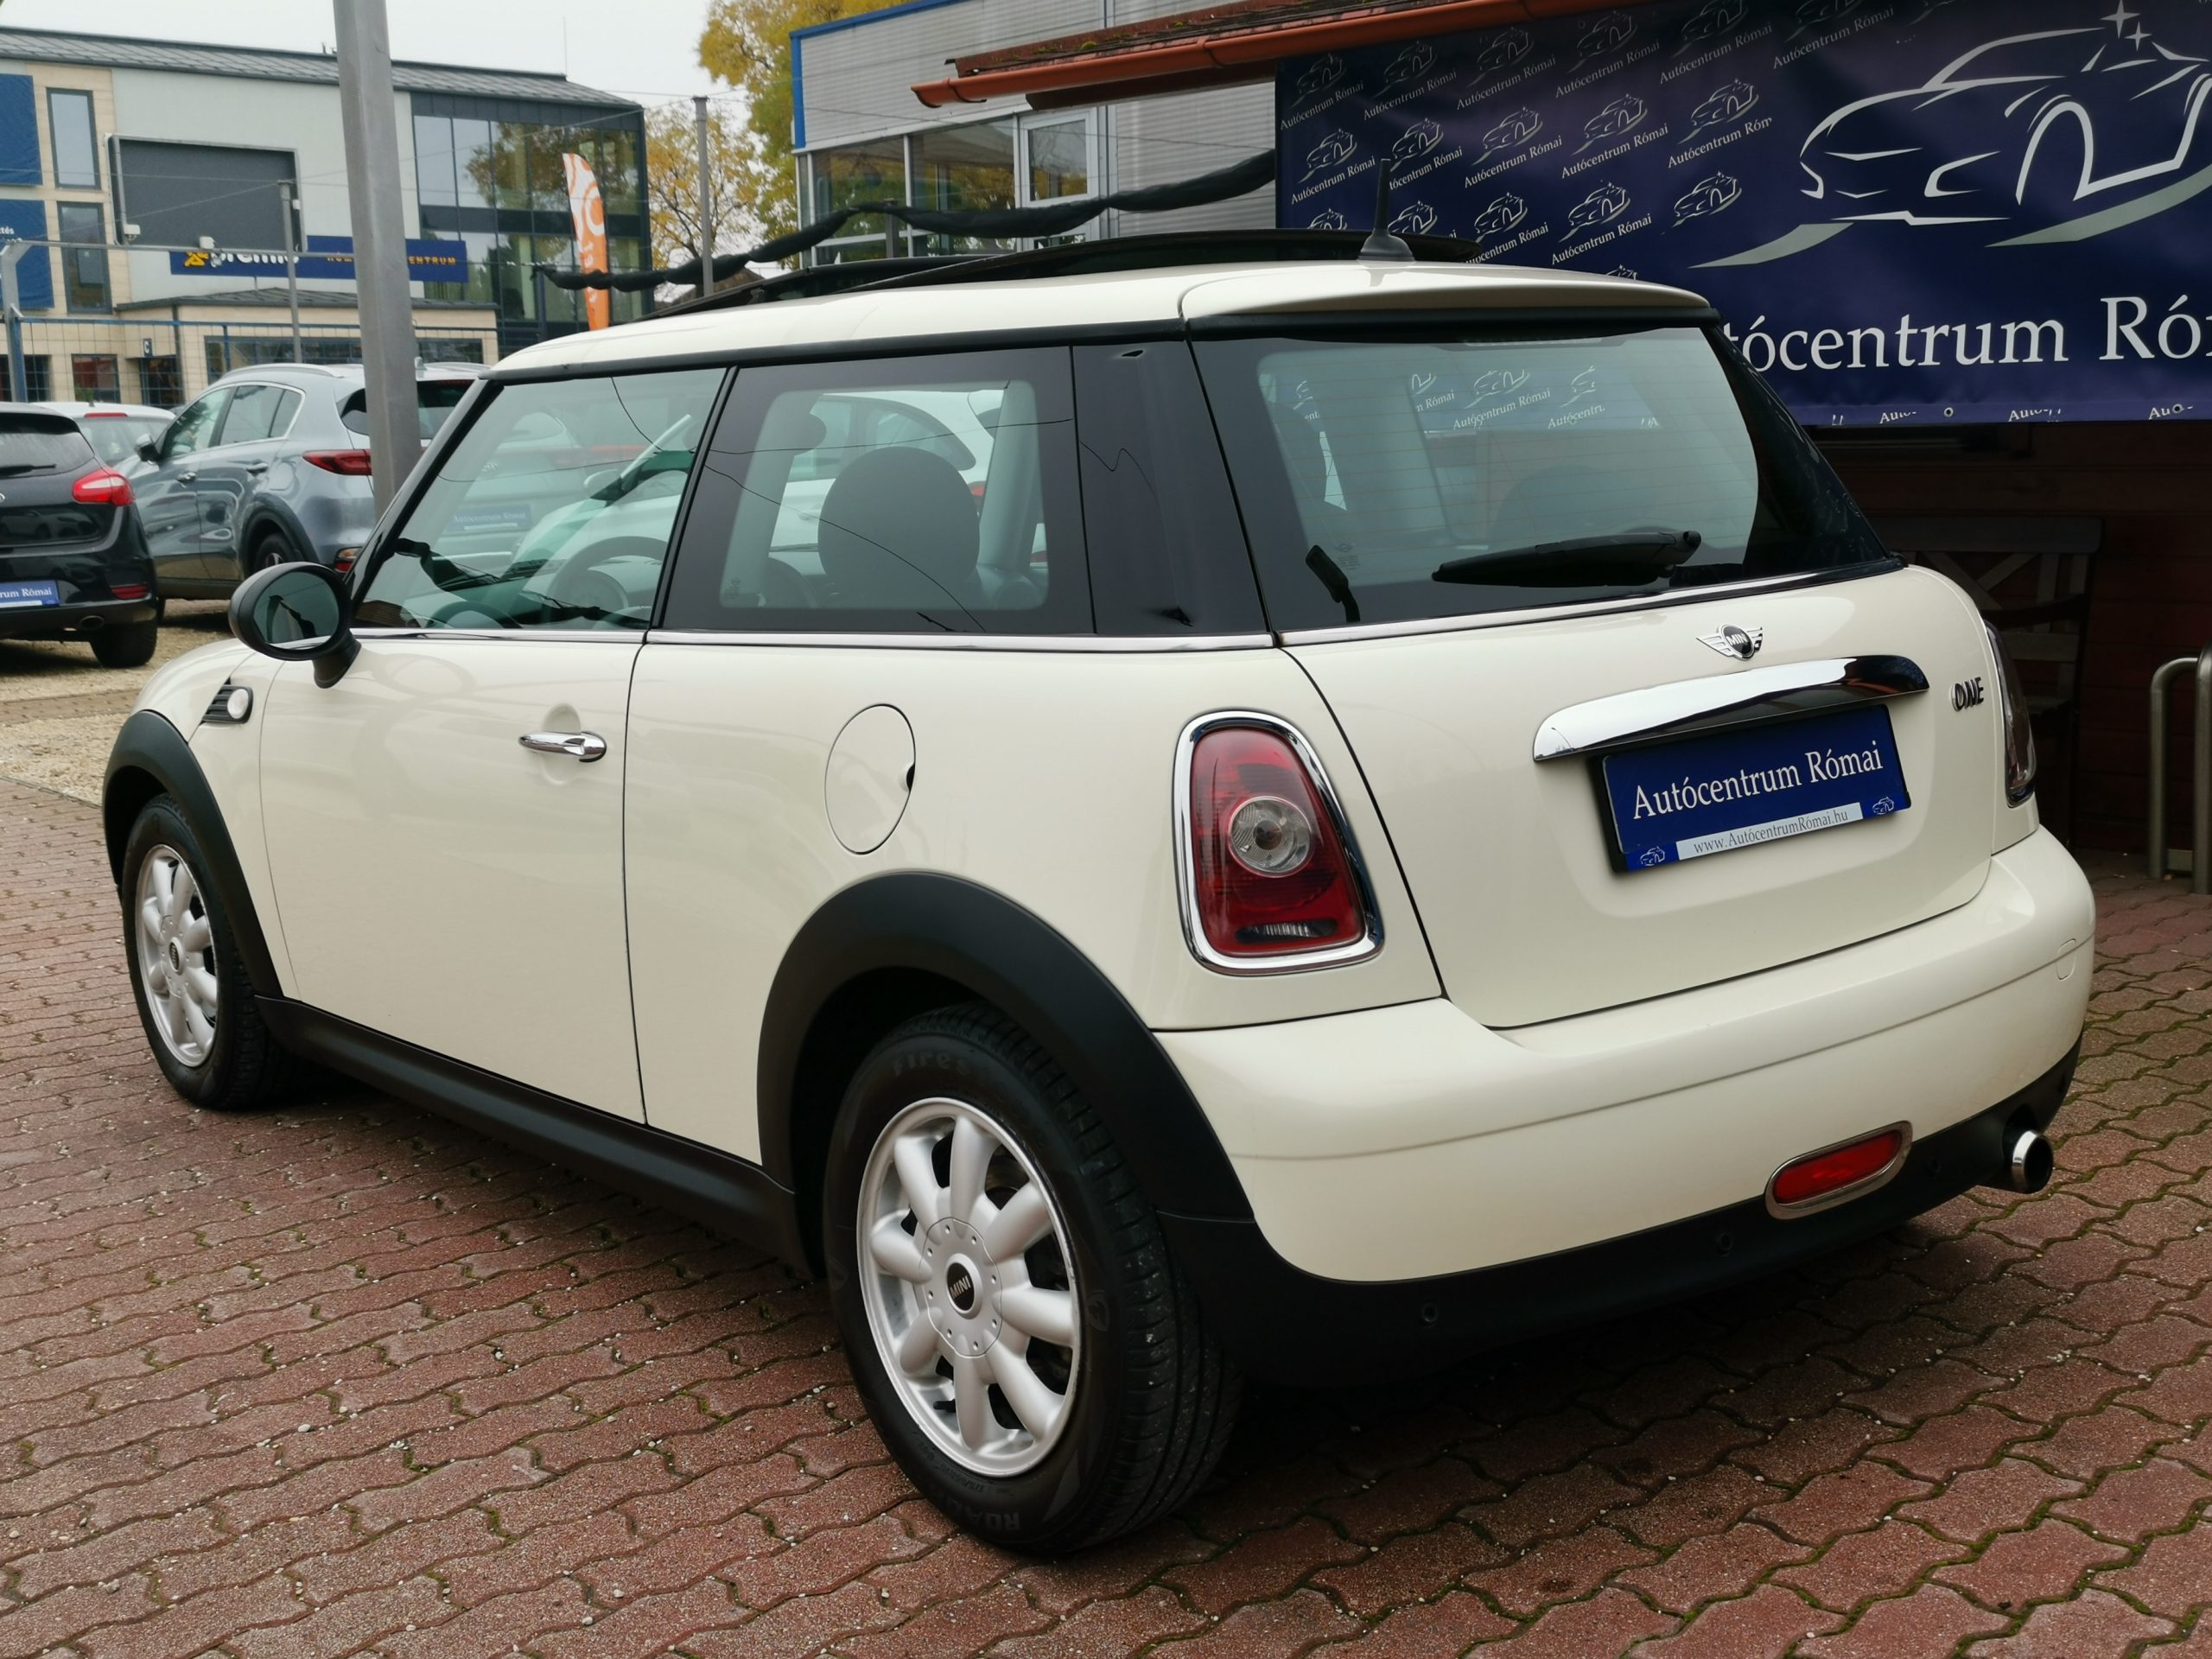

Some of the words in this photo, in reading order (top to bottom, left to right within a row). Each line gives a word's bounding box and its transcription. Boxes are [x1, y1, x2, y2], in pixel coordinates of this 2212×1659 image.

[1659, 44, 1732, 84] Autócentrum
[1734, 21, 1772, 48] Római
[1773, 29, 1851, 69] Autócentrum
[1853, 7, 1894, 31] Római
[1457, 75, 1522, 110] Autócentrum
[1523, 54, 1555, 79] Római
[1555, 61, 1624, 99] Autócentrum
[1626, 39, 1661, 64] Római
[1363, 88, 1425, 121] Autócentrum
[1427, 71, 1457, 92] Római
[1465, 154, 1527, 188] Autócentrum
[1529, 135, 1562, 158] Római
[1561, 143, 1630, 179] Autócentrum
[1633, 123, 1669, 148] Római
[1668, 129, 1742, 168] Autócentrum
[1745, 116, 1772, 135] Róm
[1291, 172, 1345, 205] Autócentrum
[1347, 155, 1376, 177] Római
[1389, 161, 1432, 191] tócentrum
[1433, 146, 1463, 168] Római
[1519, 221, 1548, 245] Római
[1552, 231, 1615, 265] Autócentrum
[1618, 213, 1651, 237] Római
[1724, 314, 2069, 372] ócentrum
[2099, 294, 2212, 360] Ró
[22, 588, 52, 597] Római
[1726, 632, 1748, 646] MIN
[1952, 677, 1984, 712] ONE
[1633, 764, 1802, 820] Autócentrum
[1805, 740, 1883, 783] Római
[1694, 809, 1849, 854] www.AutócentrumRómai.hu
[950, 1274, 971, 1300] MINI
